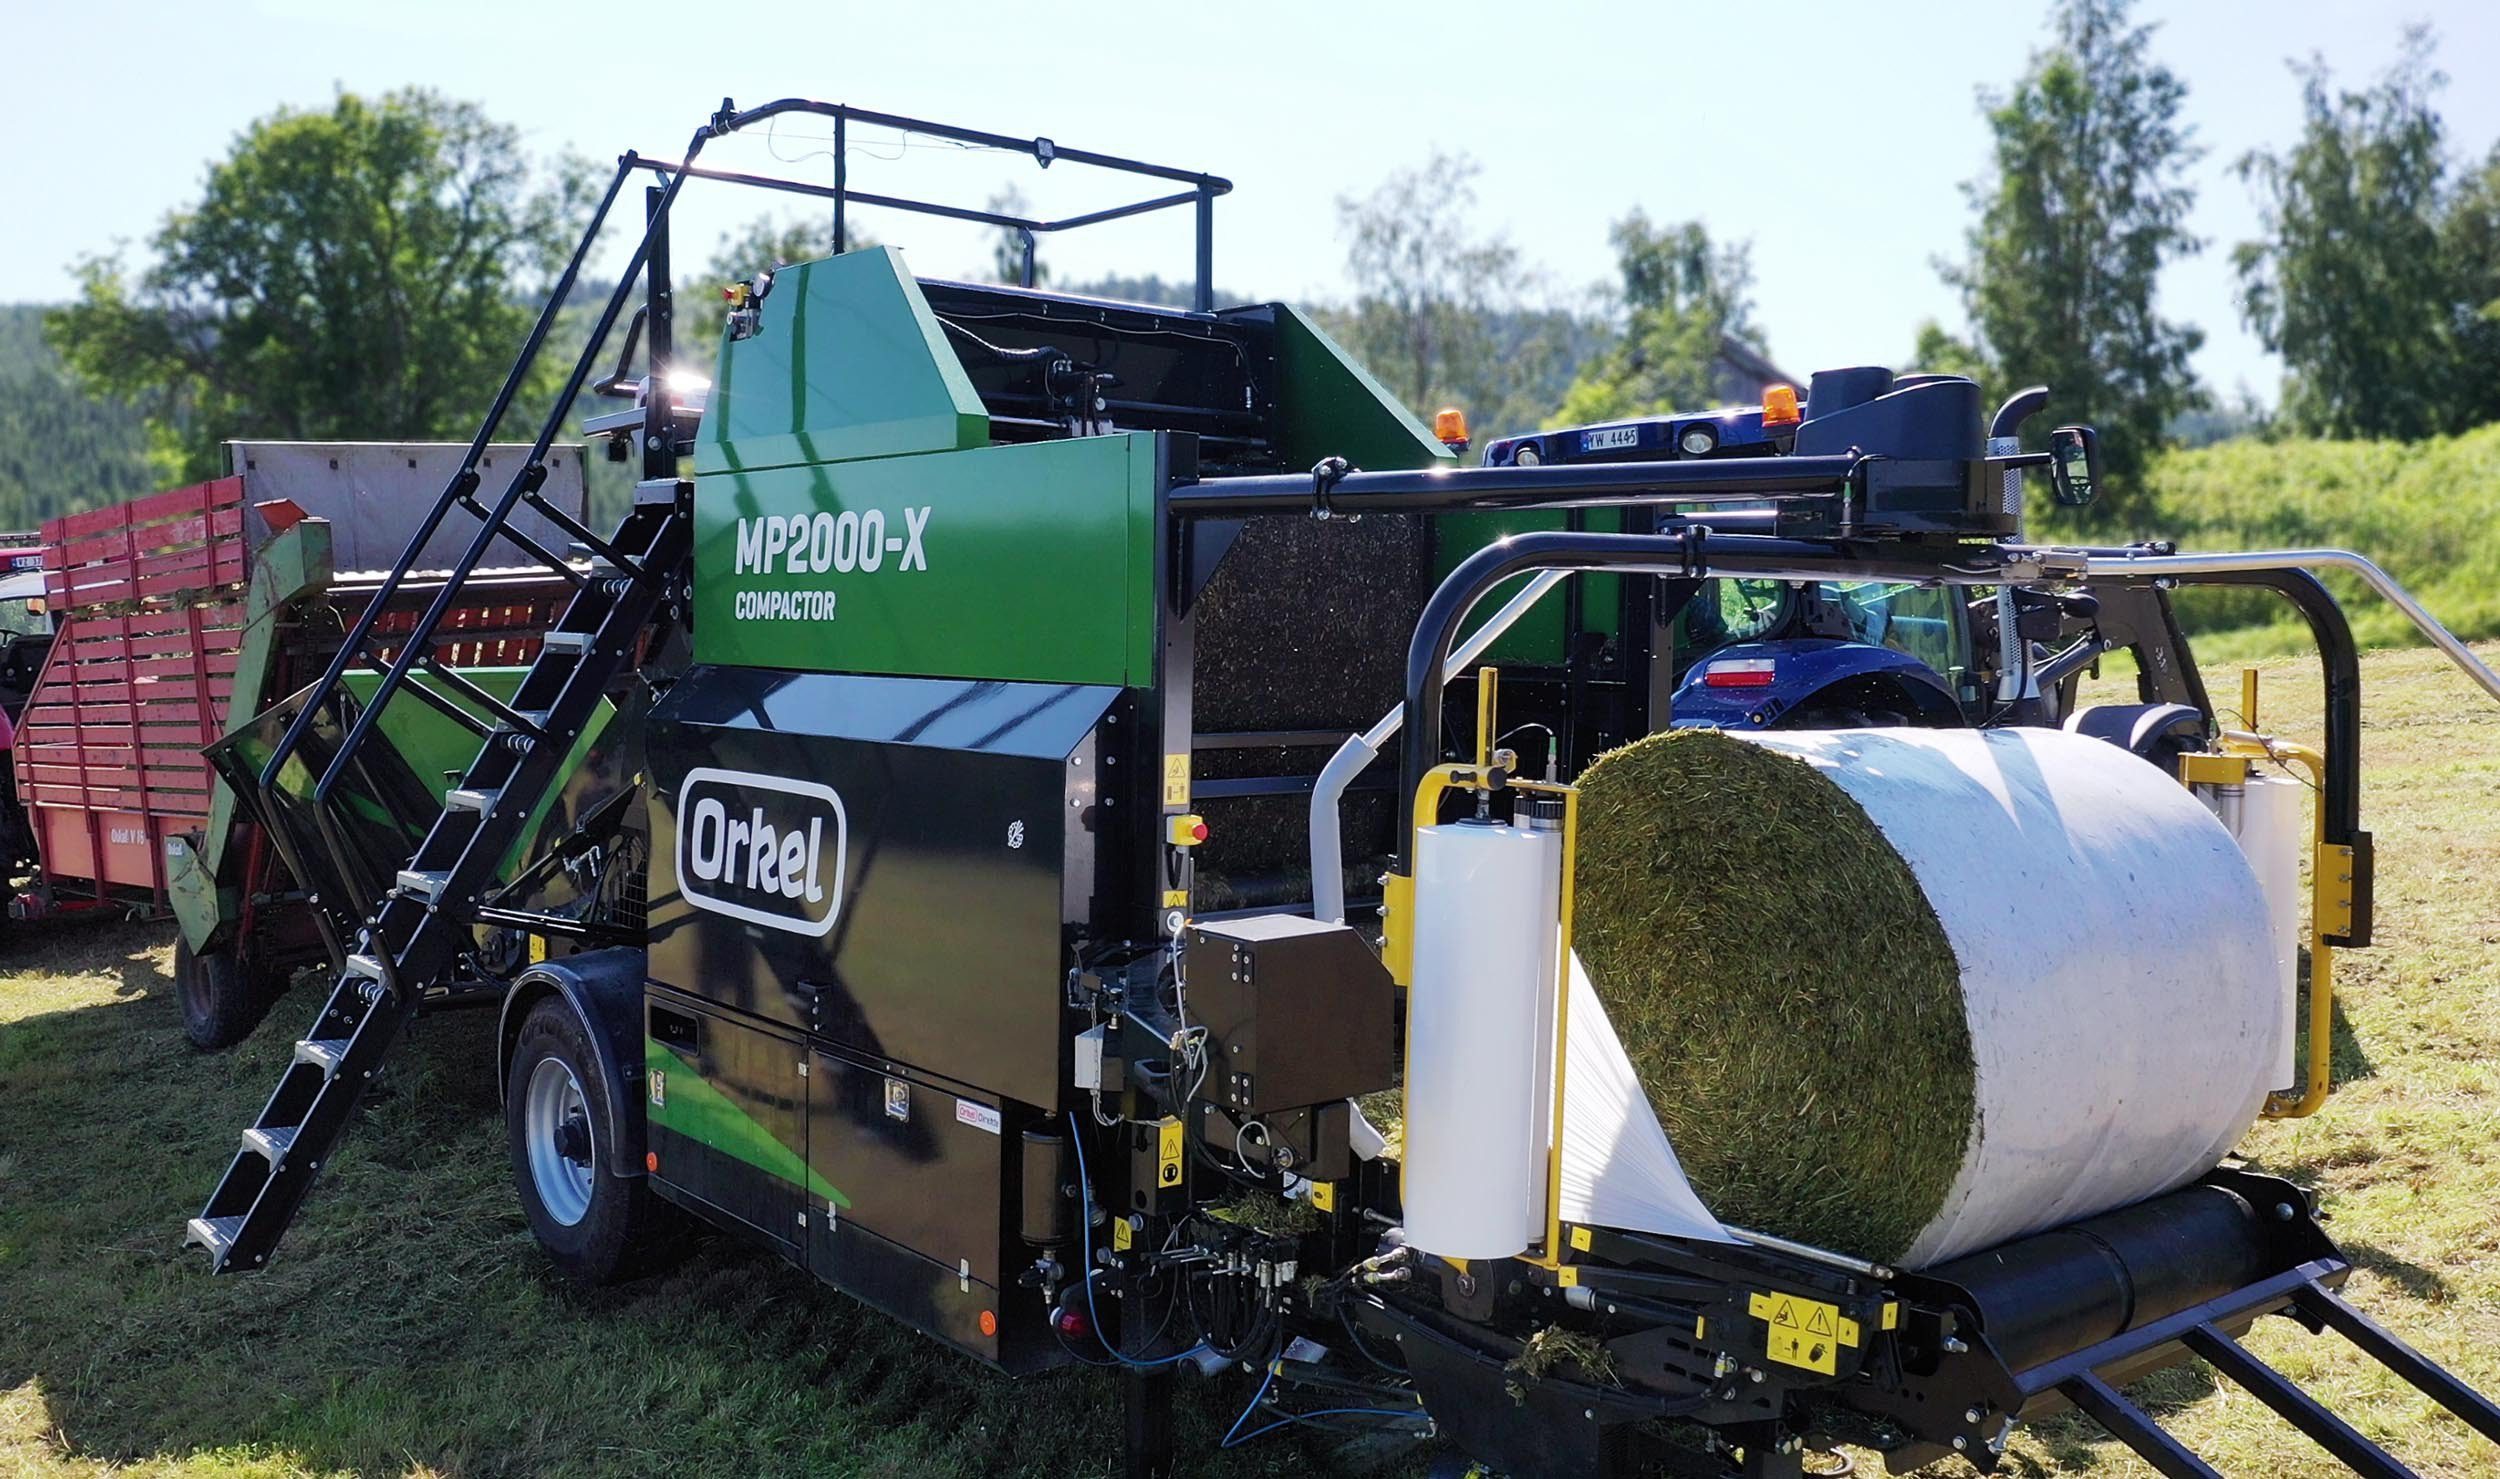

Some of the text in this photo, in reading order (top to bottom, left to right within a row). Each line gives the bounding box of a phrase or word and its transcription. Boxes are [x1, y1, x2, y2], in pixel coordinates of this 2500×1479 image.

[1589, 433, 1604, 448] YW
[735, 506, 931, 574] MP2000-X
[735, 591, 836, 621] COMPACTOR
[692, 798, 823, 903] Orkel
